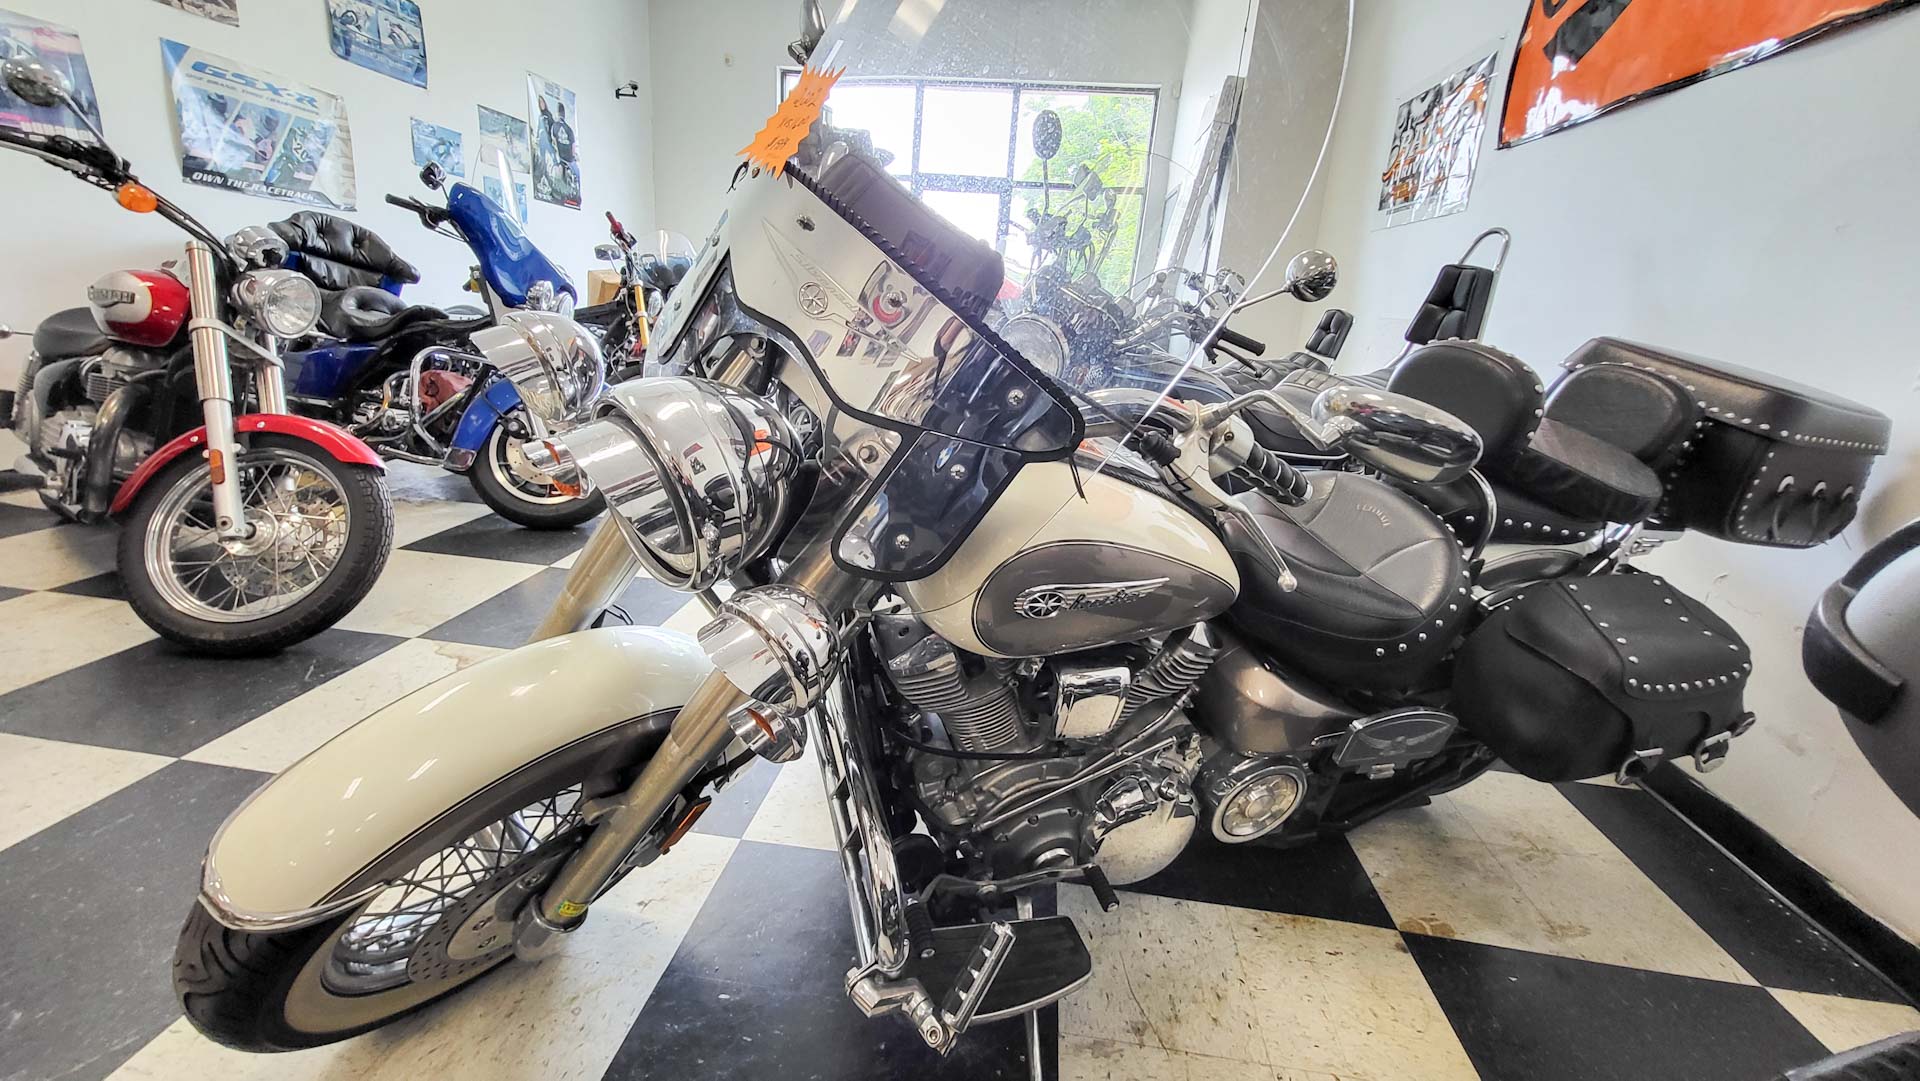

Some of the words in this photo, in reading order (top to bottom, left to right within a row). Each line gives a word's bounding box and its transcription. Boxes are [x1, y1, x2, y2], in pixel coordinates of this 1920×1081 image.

[191, 61, 319, 109] GSX-R
[192, 171, 225, 184] OWN
[227, 178, 249, 190] THE
